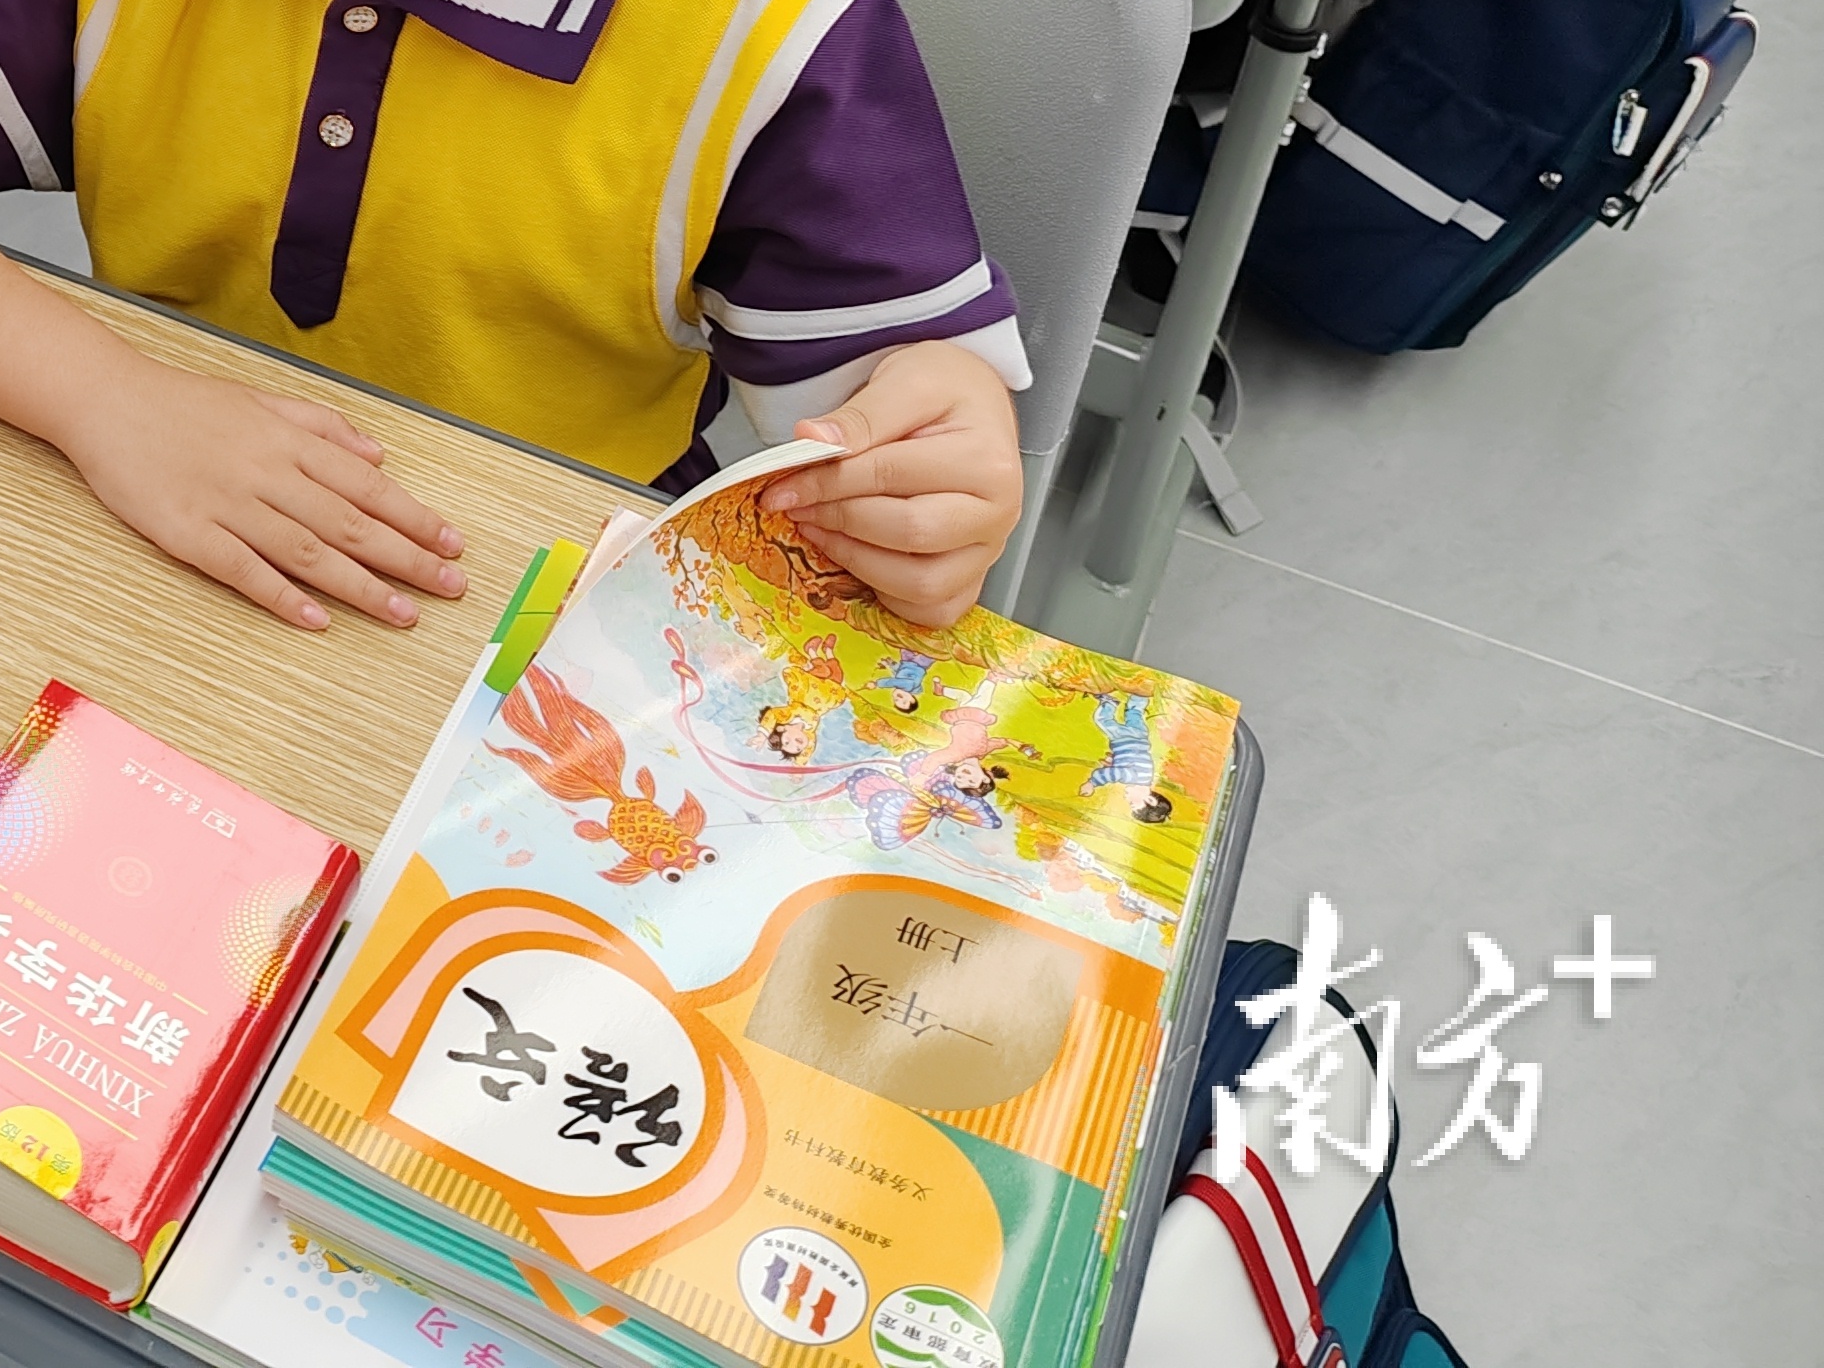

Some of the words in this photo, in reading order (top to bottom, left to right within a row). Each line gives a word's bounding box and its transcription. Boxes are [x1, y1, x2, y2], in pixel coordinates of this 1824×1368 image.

[895, 916, 980, 964] 上册
[831, 963, 995, 1047] 一年级
[447, 987, 684, 1169] 语文
[783, 1128, 935, 1203] 义务教育教科书
[762, 1184, 894, 1250] 全国优秀教材特等奖
